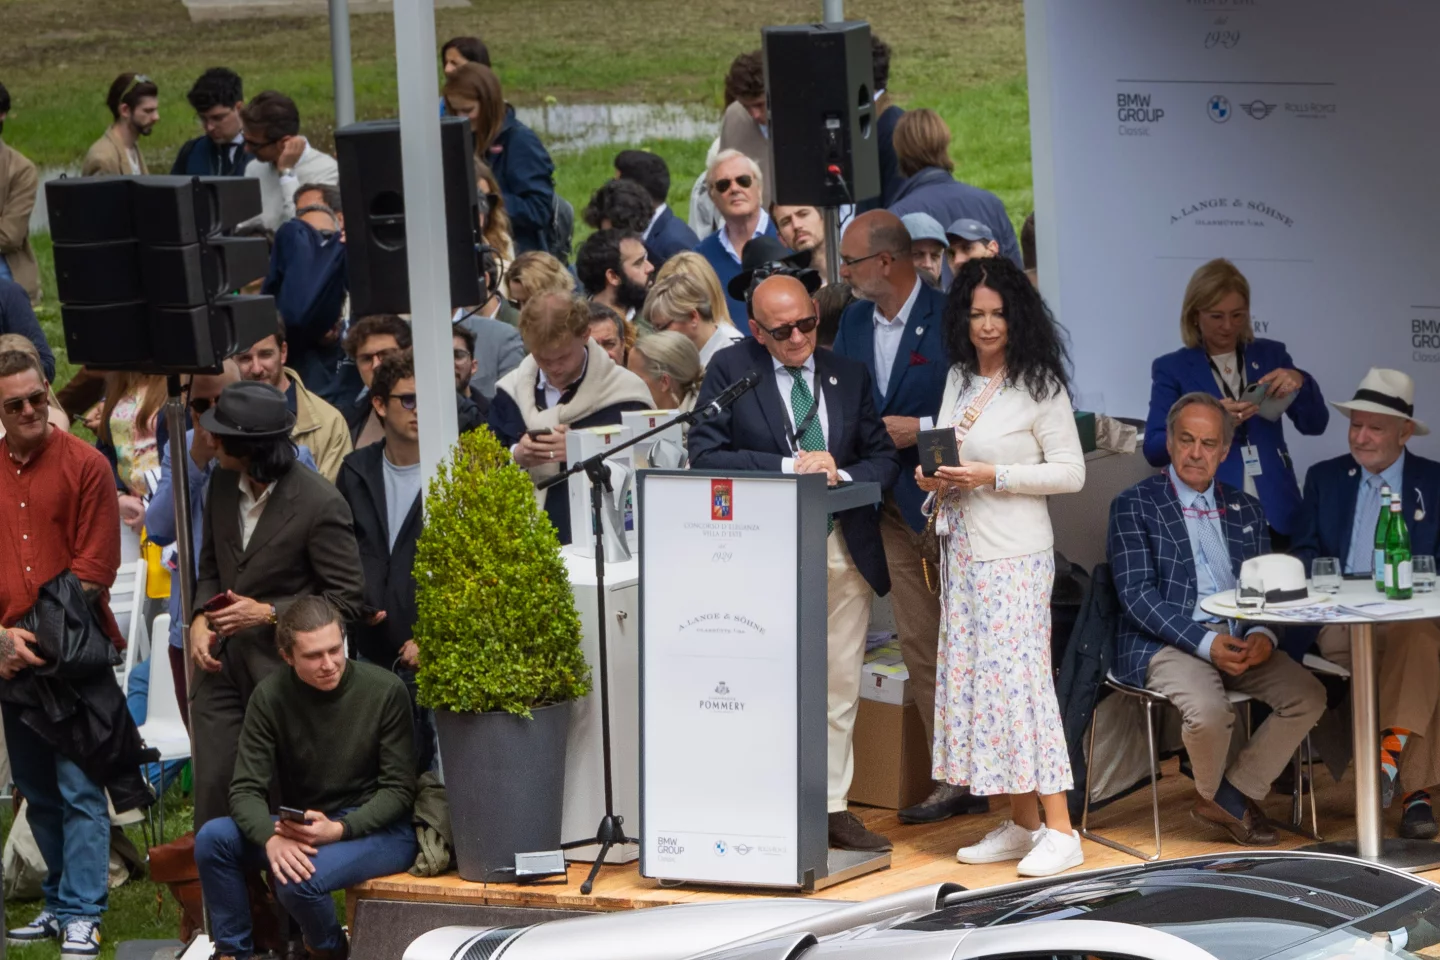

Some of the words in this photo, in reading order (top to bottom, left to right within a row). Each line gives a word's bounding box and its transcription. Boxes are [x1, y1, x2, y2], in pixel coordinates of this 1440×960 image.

[1204, 30, 1240, 49] 1929
[1117, 93, 1151, 107] BMW
[1117, 109, 1165, 122] GROUP
[1118, 125, 1151, 137] Classic
[1181, 198, 1228, 217] LANGE
[1232, 199, 1243, 208] &
[1247, 200, 1295, 228] SÖHNE
[684, 522, 720, 530] CONCORSO
[711, 552, 733, 563] 1929
[687, 613, 721, 626] LANGE
[733, 615, 766, 635] SÖHNE
[699, 700, 745, 711] POMMERY
[657, 837, 677, 846] BMW
[657, 846, 684, 855] GROUP
